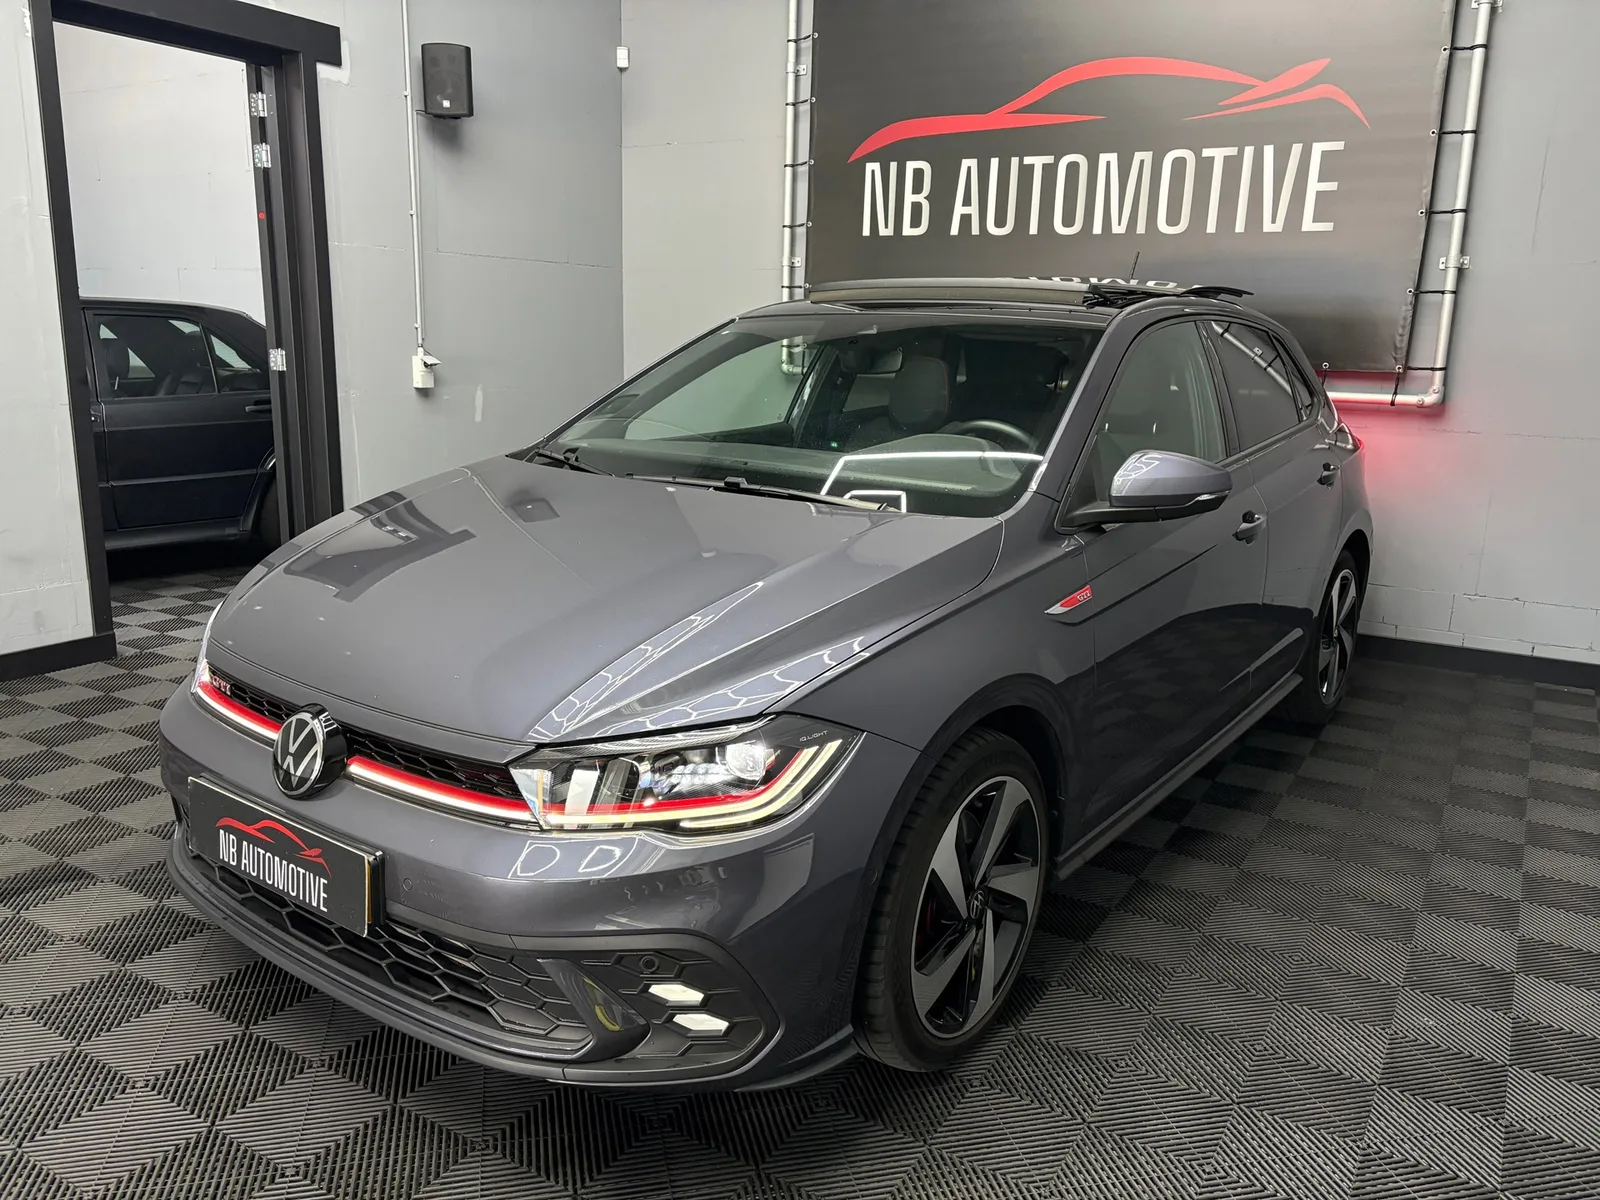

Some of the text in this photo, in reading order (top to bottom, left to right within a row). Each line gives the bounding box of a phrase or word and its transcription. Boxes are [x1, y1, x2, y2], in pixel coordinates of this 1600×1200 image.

[861, 140, 1346, 237] NB AUTOMOTIVE
[219, 828, 328, 913] NB AUTOMOTIVE
